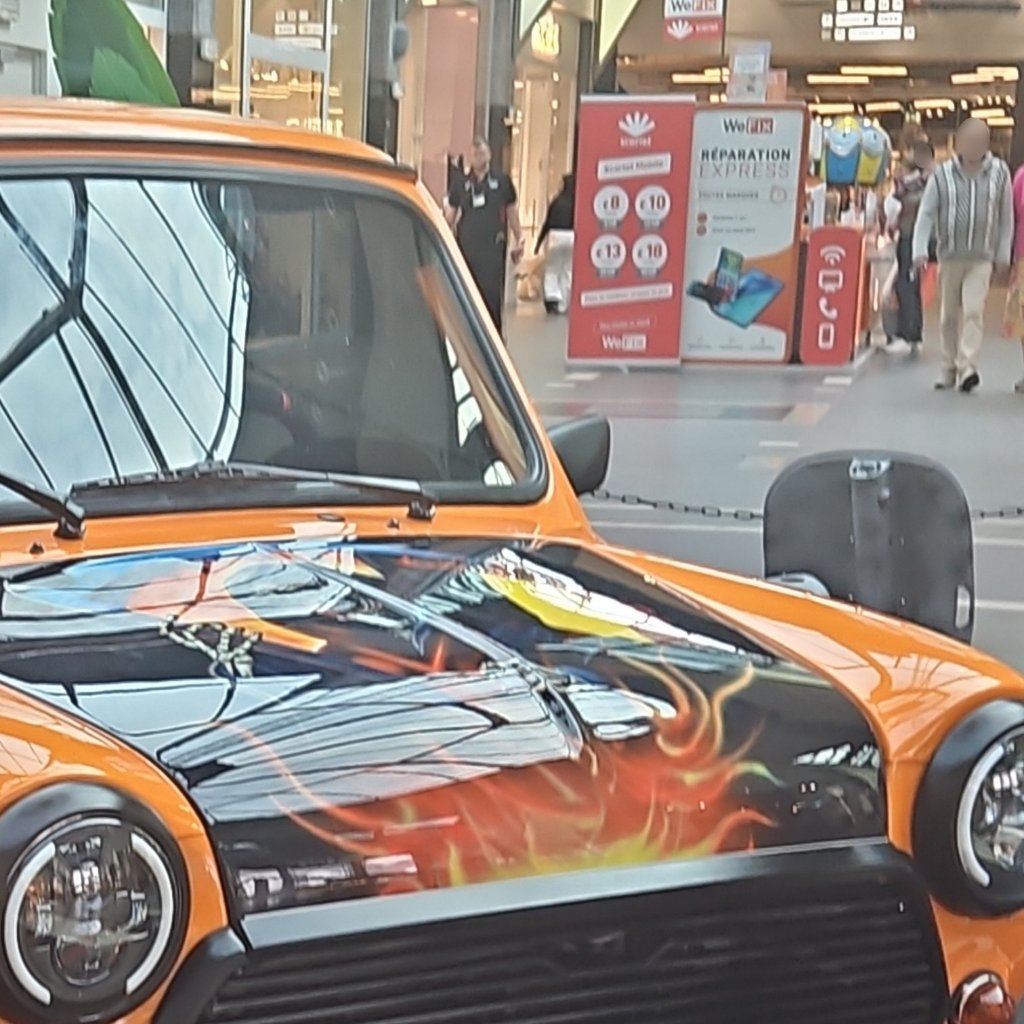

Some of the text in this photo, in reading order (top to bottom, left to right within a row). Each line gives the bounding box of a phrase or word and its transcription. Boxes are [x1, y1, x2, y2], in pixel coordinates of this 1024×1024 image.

[723, 117, 774, 133] WeFIX
[701, 147, 791, 161] RÉPARATION
[699, 163, 790, 178] EXPRESS
